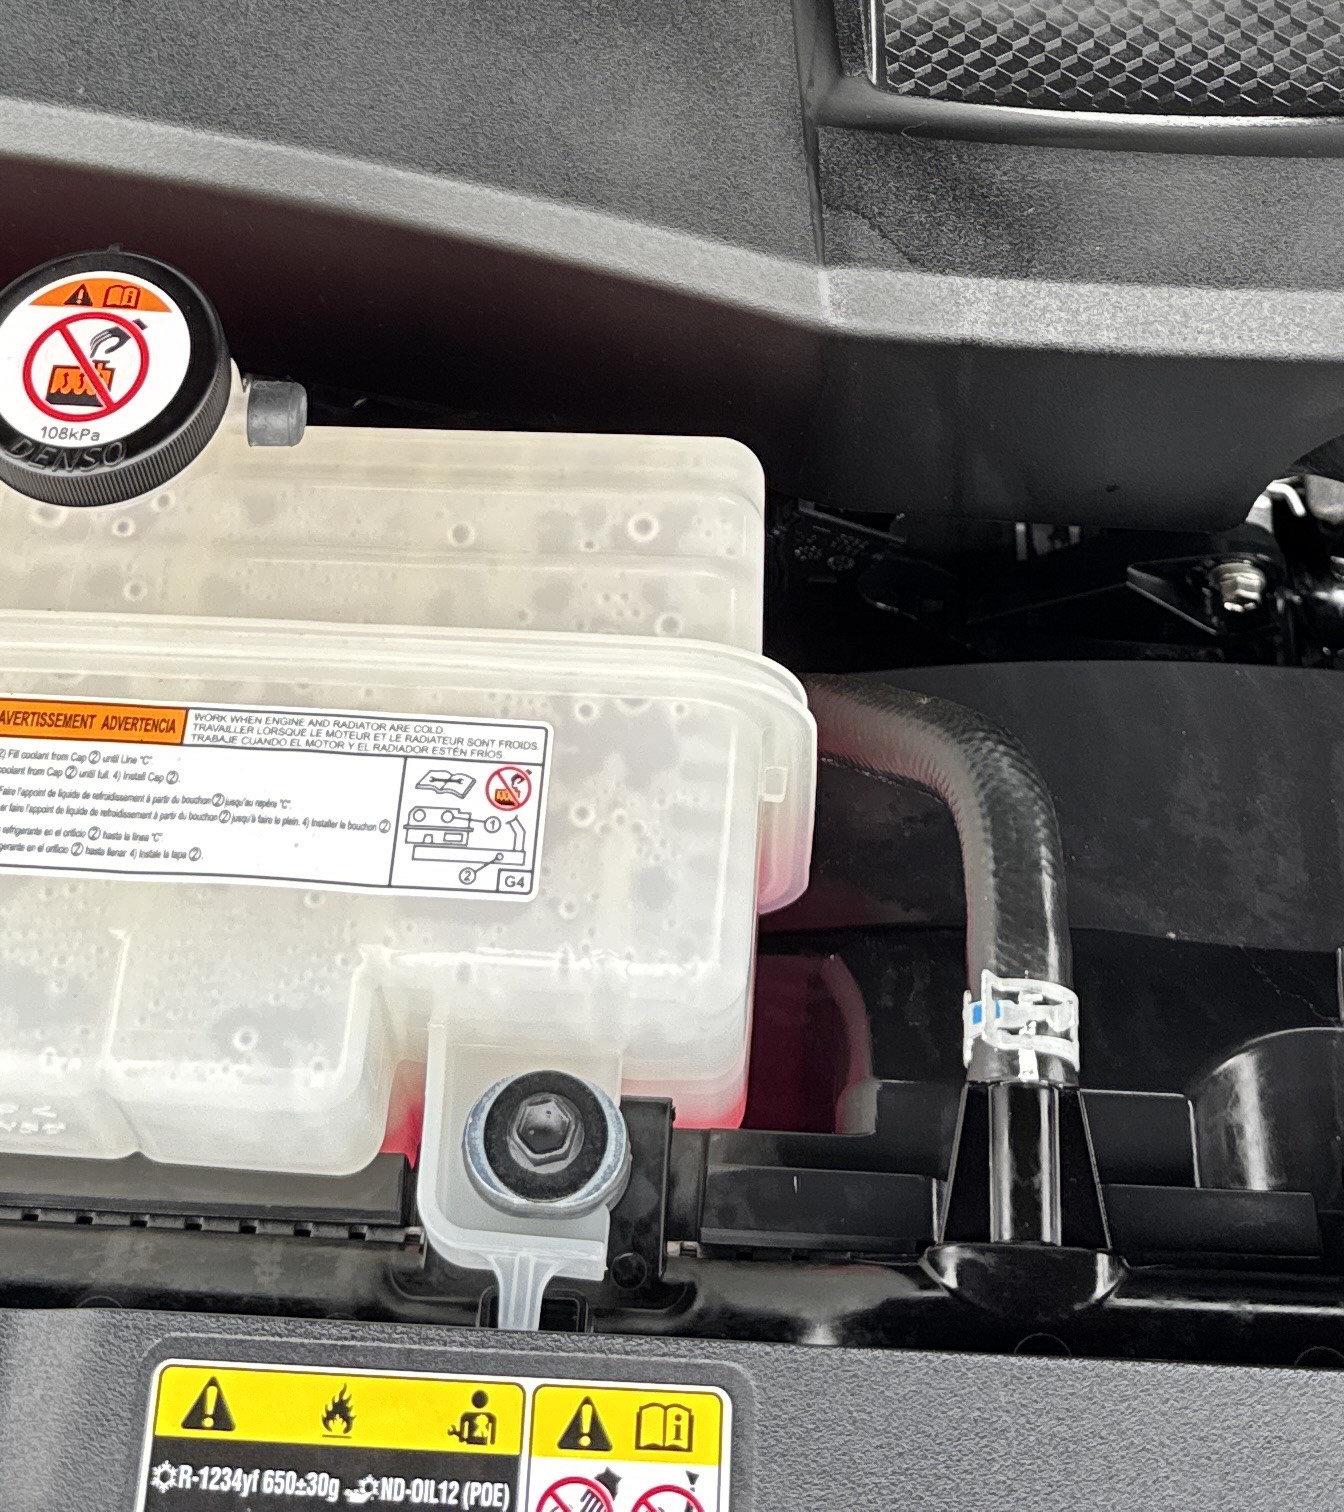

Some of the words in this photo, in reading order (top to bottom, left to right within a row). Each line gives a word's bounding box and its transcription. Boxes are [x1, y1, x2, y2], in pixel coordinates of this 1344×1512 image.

[41, 426, 101, 442] 108kPa
[6, 437, 126, 473] DENSO
[100, 714, 177, 734] ADVERTENCIA
[194, 712, 227, 722] WORK
[230, 714, 262, 725] WHEN
[265, 716, 305, 727] ENGINE
[307, 718, 330, 728] AND
[333, 720, 386, 732] RADIATOR
[389, 723, 411, 733] ARE
[191, 733, 238, 744] TRABAJE
[241, 736, 288, 747] CUANDO
[290, 738, 302, 747] EL
[305, 739, 346, 749] MOTOR
[348, 740, 355, 749] Y
[357, 742, 369, 752] EL
[373, 743, 429, 754] RADIADOR
[192, 723, 255, 735] TRAVAILLER
[257, 726, 307, 737] LORSQUE
[310, 729, 322, 738] LE
[326, 729, 371, 741] MOTEUR
[374, 732, 387, 742] ET
[389, 733, 403, 743] LE
[405, 734, 464, 746] RADIATEUR
[467, 738, 496, 748] SONT
[71, 752, 87, 764] Cap
[47, 767, 64, 779] Cap
[148, 772, 165, 784] Cap
[504, 875, 526, 889] G4
[179, 1465, 261, 1498] R-1234yf
[262, 1469, 340, 1503] 650±30g
[380, 1476, 460, 1506] ND-OIL12
[461, 1480, 511, 1512] (POE)
